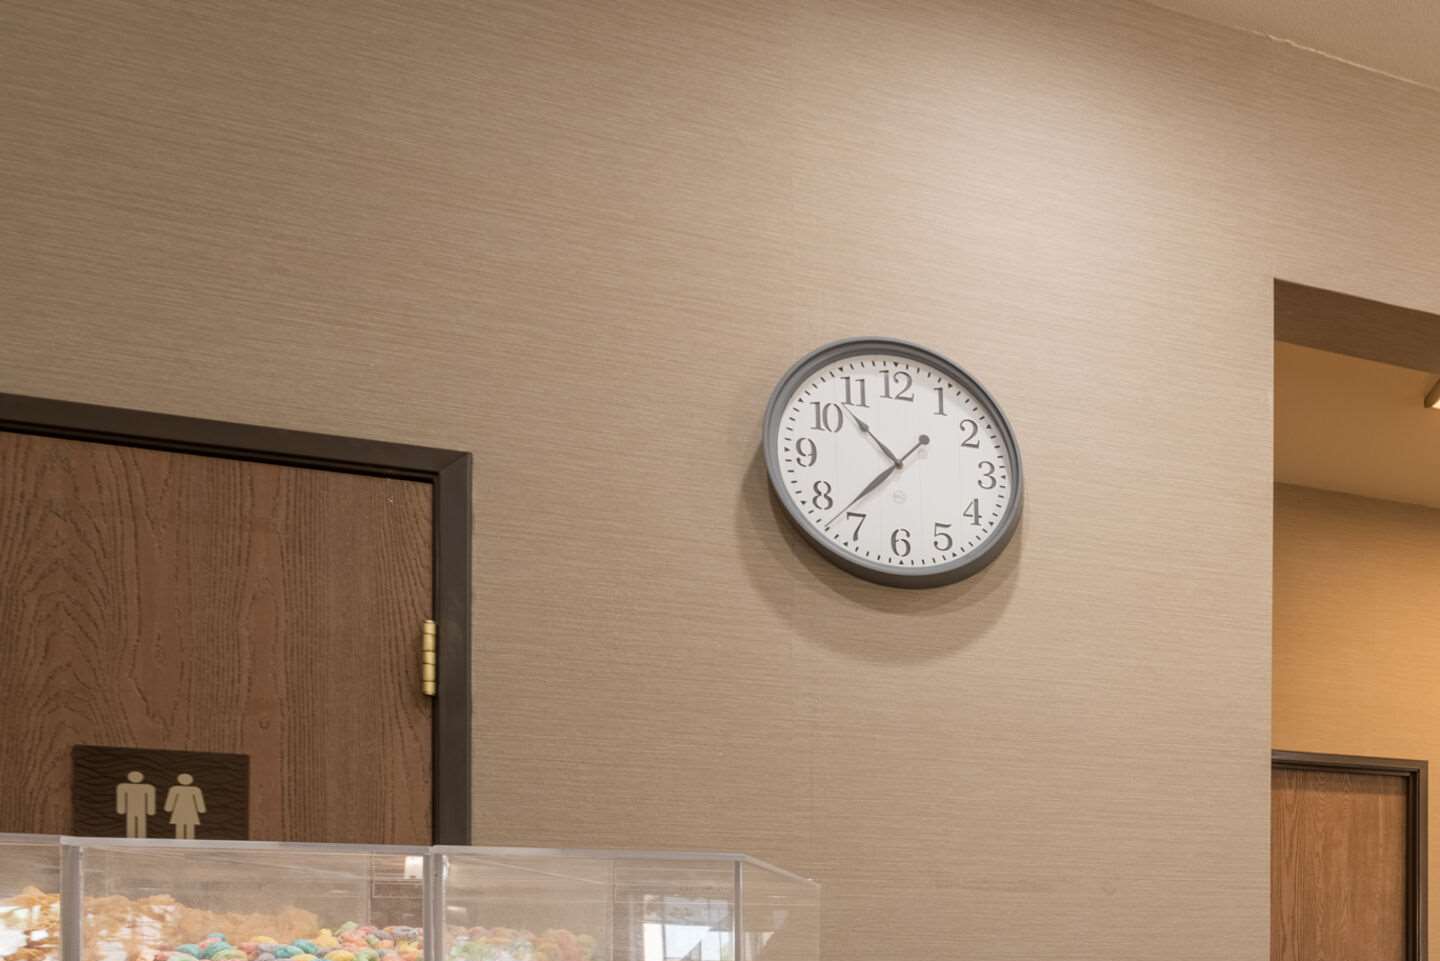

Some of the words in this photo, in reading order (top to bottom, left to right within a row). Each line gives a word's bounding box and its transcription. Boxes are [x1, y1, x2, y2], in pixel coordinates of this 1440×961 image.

[840, 376, 870, 408] 11
[879, 369, 915, 402] 12
[933, 387, 948, 416] 1
[810, 401, 844, 433] 10
[959, 419, 981, 448] 2
[795, 438, 817, 467] 9
[977, 461, 997, 489] 3
[812, 480, 833, 510] 8
[846, 512, 867, 541] 7
[963, 499, 982, 526] 4
[890, 529, 911, 557] 6
[933, 522, 952, 551] 5
